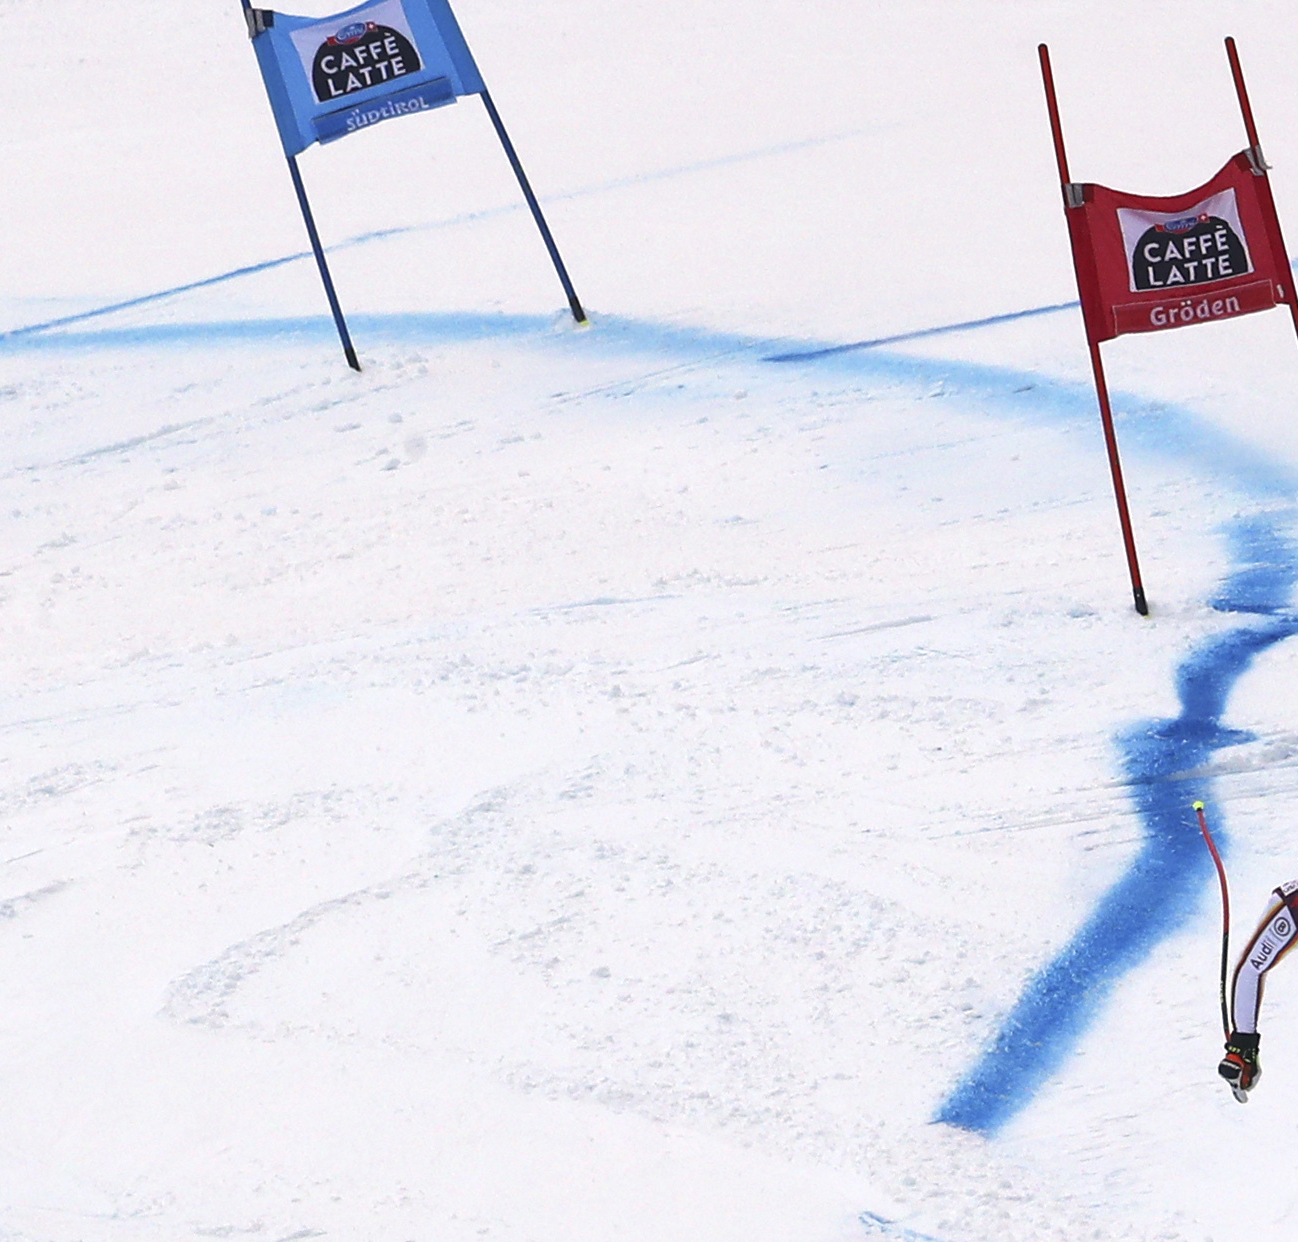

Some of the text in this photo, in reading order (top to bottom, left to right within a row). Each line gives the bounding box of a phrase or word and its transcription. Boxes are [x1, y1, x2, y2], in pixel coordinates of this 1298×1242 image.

[320, 33, 399, 74] CAFFÈ
[327, 56, 406, 97] LATTE
[1144, 225, 1230, 263] CAFFÈ
[1148, 254, 1233, 287] LATTE
[1150, 296, 1240, 326] Gröden
[1250, 940, 1275, 970] Audi
